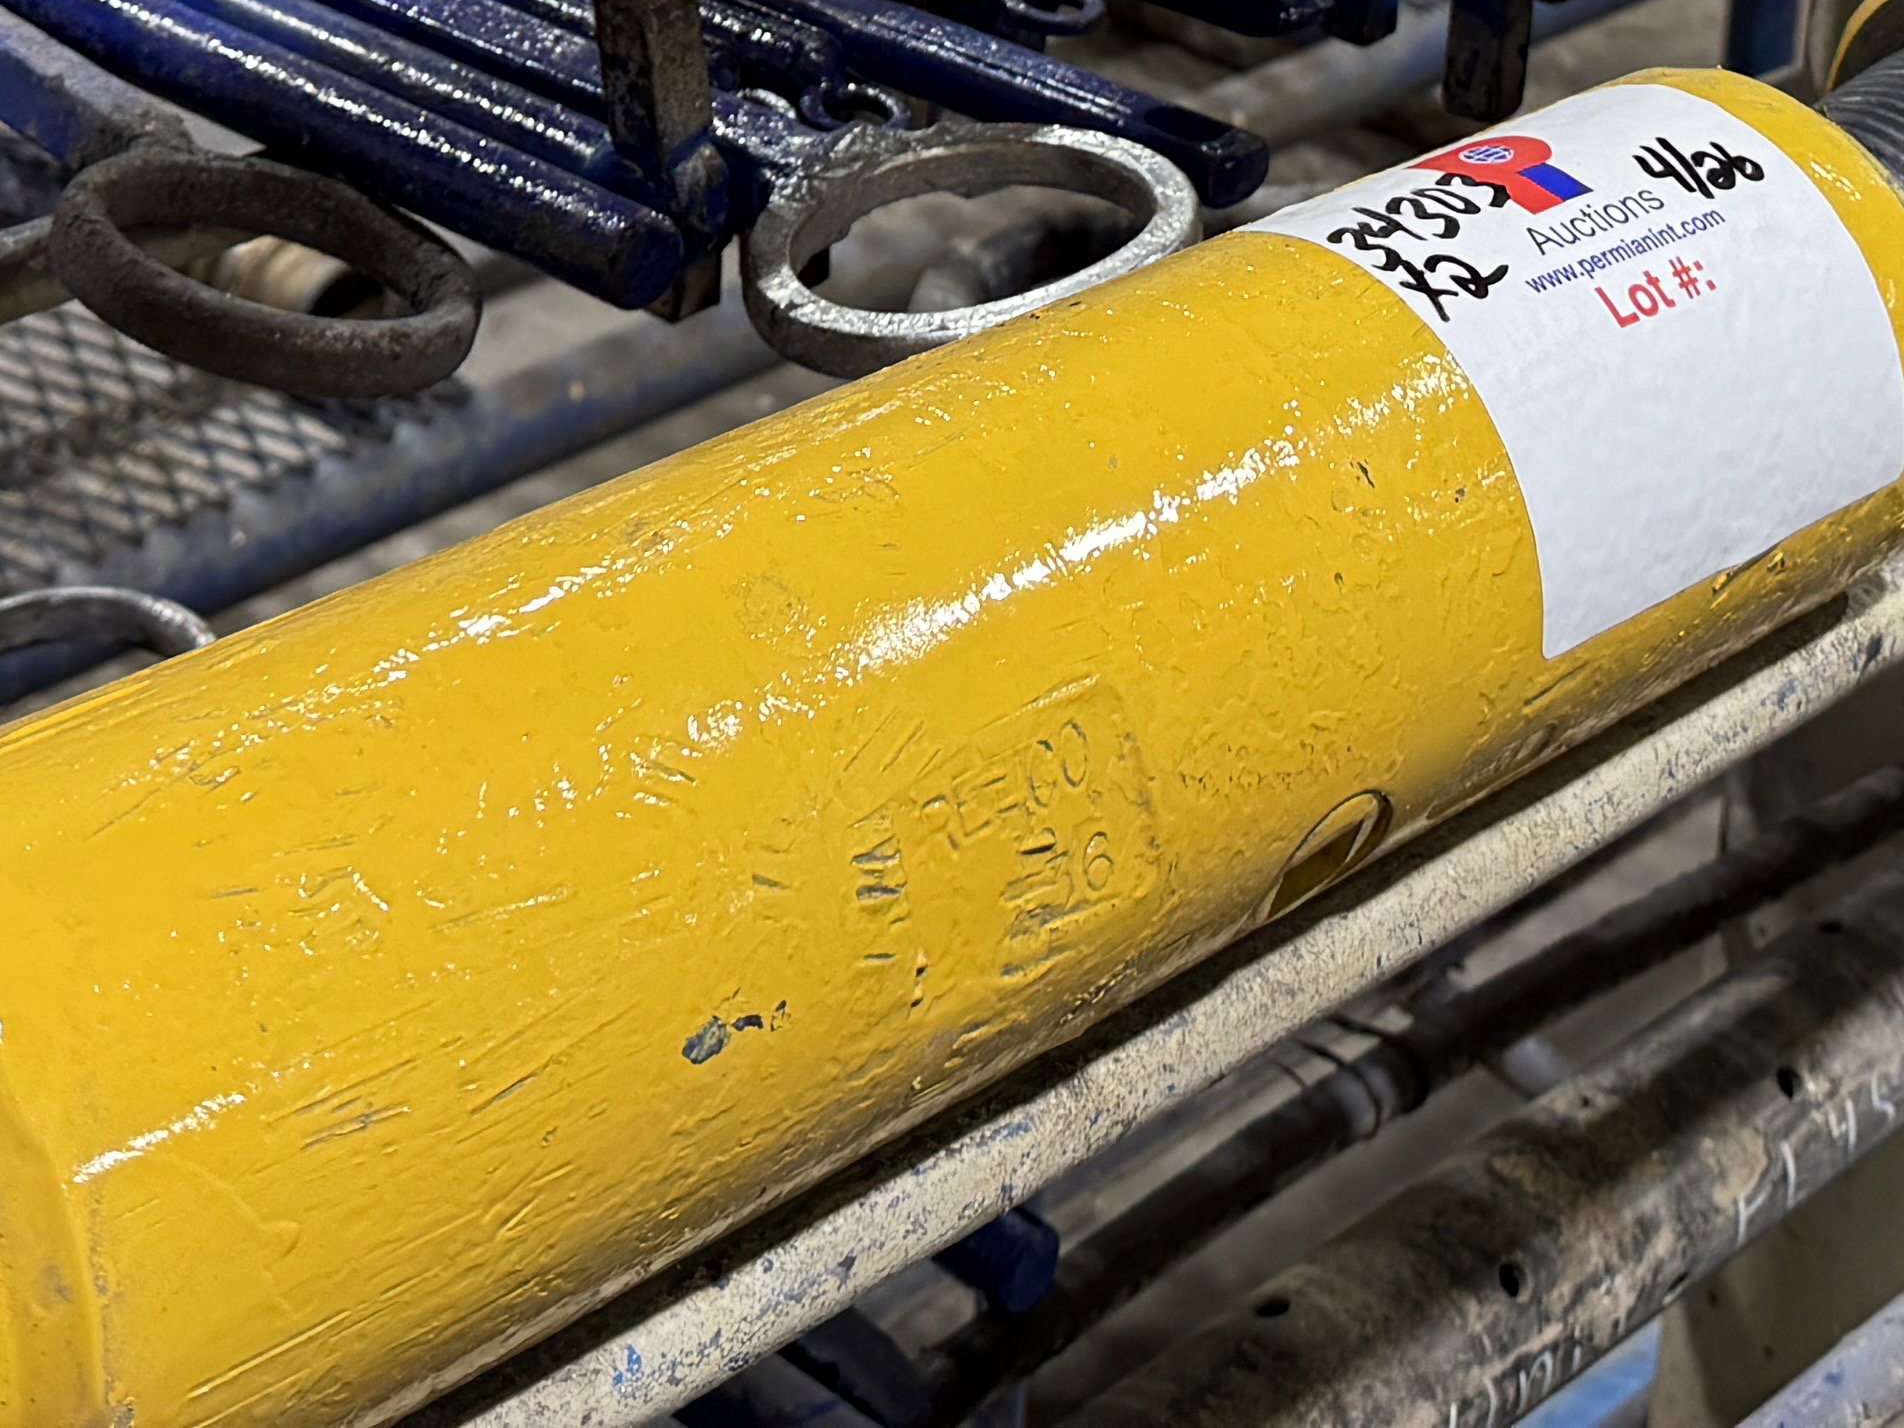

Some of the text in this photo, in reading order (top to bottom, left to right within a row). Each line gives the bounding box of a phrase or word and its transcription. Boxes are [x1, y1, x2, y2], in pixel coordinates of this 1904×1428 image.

[1632, 136, 1766, 200] 4/26
[1327, 172, 1510, 272] 34303
[1524, 186, 1665, 257] Auctions
[1524, 205, 1726, 294] www.permianint.com
[1594, 255, 1718, 329] Lot #:
